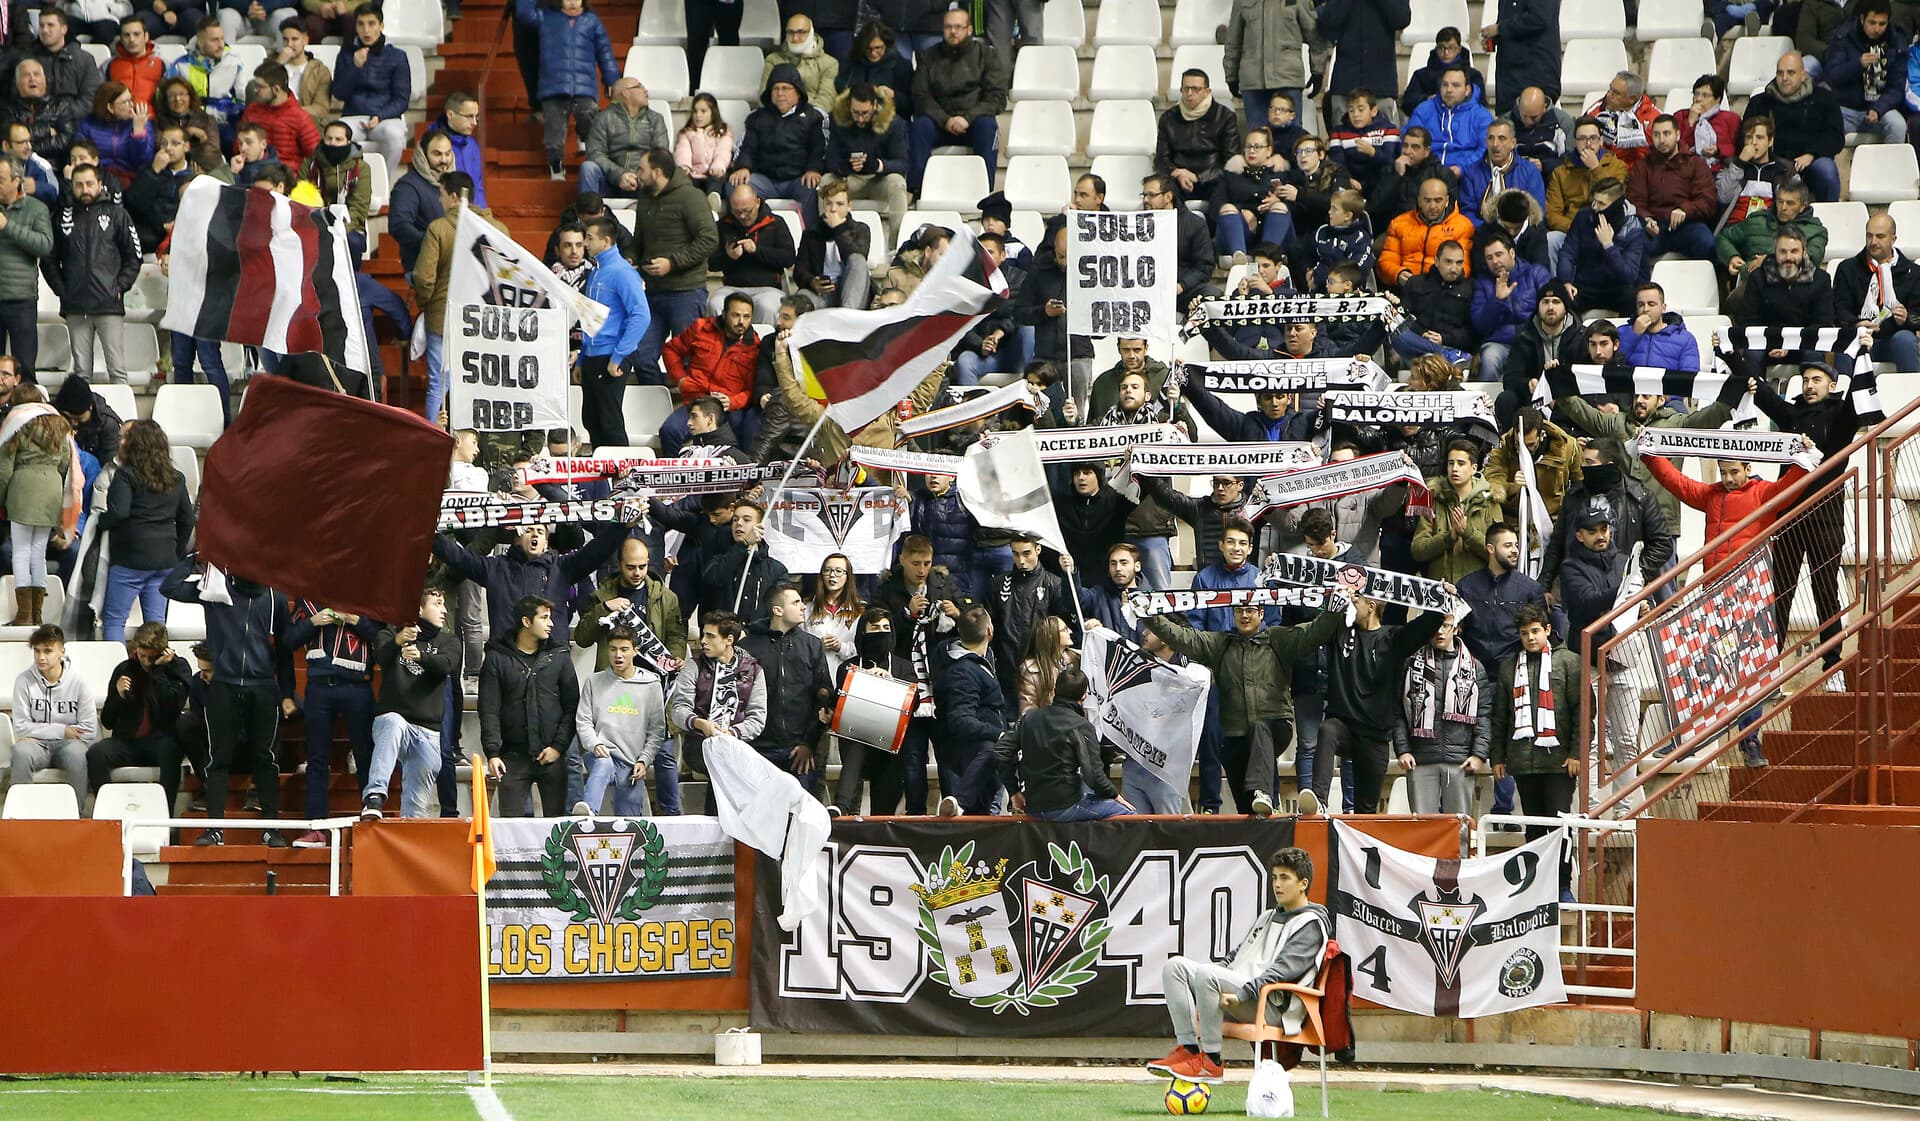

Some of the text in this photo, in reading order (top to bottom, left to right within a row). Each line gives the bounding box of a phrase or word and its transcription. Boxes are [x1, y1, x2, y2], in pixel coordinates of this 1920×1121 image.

[1077, 212, 1154, 242] SOLO
[1079, 255, 1155, 288] SOLO
[1091, 300, 1151, 333] ABP
[1223, 301, 1318, 317] ALBACETE
[462, 304, 539, 342] SOLO
[462, 350, 539, 389] SOLO
[1204, 373, 1328, 390] BALOMPIÉ
[1206, 361, 1326, 376] ALBACETE
[1334, 392, 1454, 408] ALBACETE
[472, 398, 534, 430] ABP
[1331, 406, 1455, 423] BALOMPIÉ
[1089, 430, 1164, 449] BALOMPIÉ
[1660, 435, 1784, 452] ALBACETE BALOMPIÉ
[556, 459, 616, 474] ALBACETE
[1131, 451, 1284, 465] ALBACETE BALOMPIÉ
[644, 466, 774, 486] ALBACETE BALOMPIE
[1278, 471, 1349, 494] ALBACETE
[437, 500, 617, 531] ABP FANS
[1271, 553, 1449, 610] ABP FANS
[1149, 587, 1326, 614] ABP FANS
[608, 704, 639, 715] adidas
[1361, 847, 1540, 897] 1 9
[1351, 899, 1402, 936] Albacete
[487, 919, 735, 975] LOS CHOSPES
[1357, 945, 1392, 993] 4
